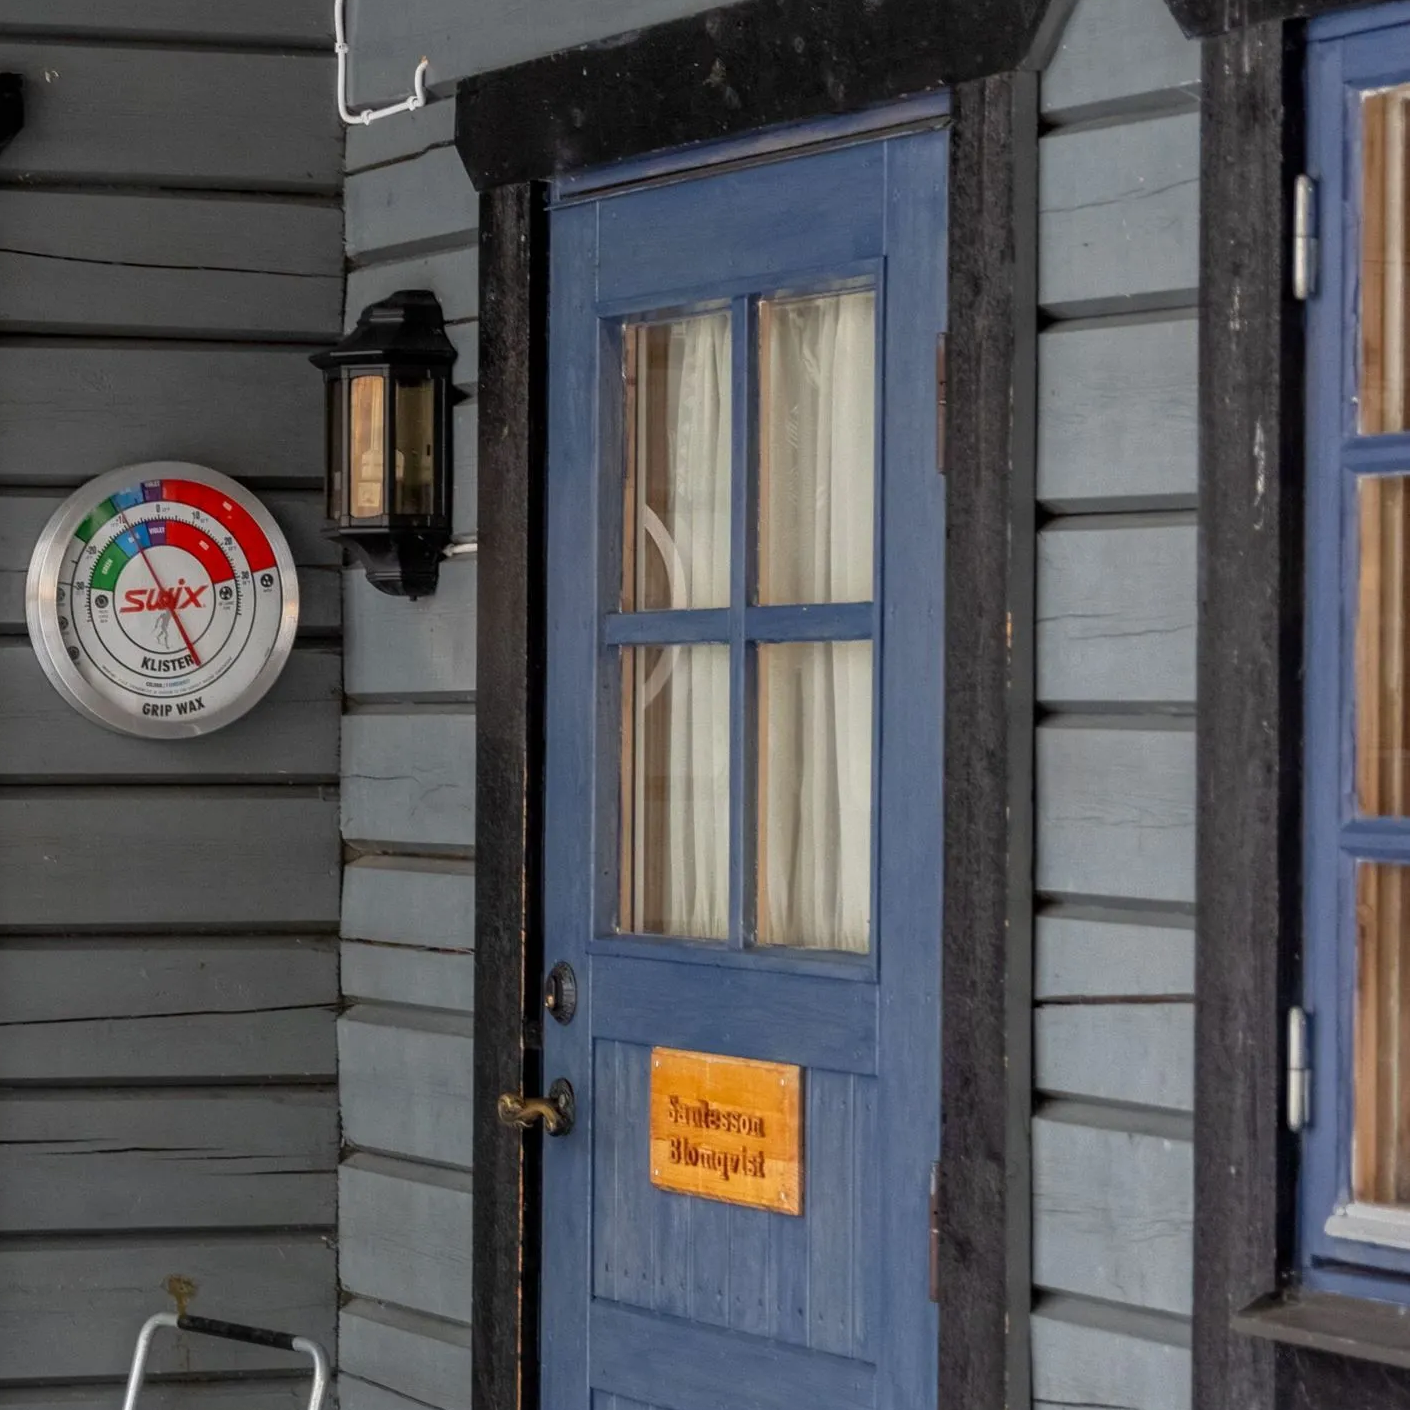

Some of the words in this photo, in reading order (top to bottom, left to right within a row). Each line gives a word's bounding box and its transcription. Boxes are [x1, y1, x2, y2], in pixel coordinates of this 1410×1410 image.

[141, 654, 195, 673] KLISTER
[142, 702, 173, 718] GRIP
[176, 697, 206, 716] WAX
[668, 1136, 766, 1181] Blomqvist
